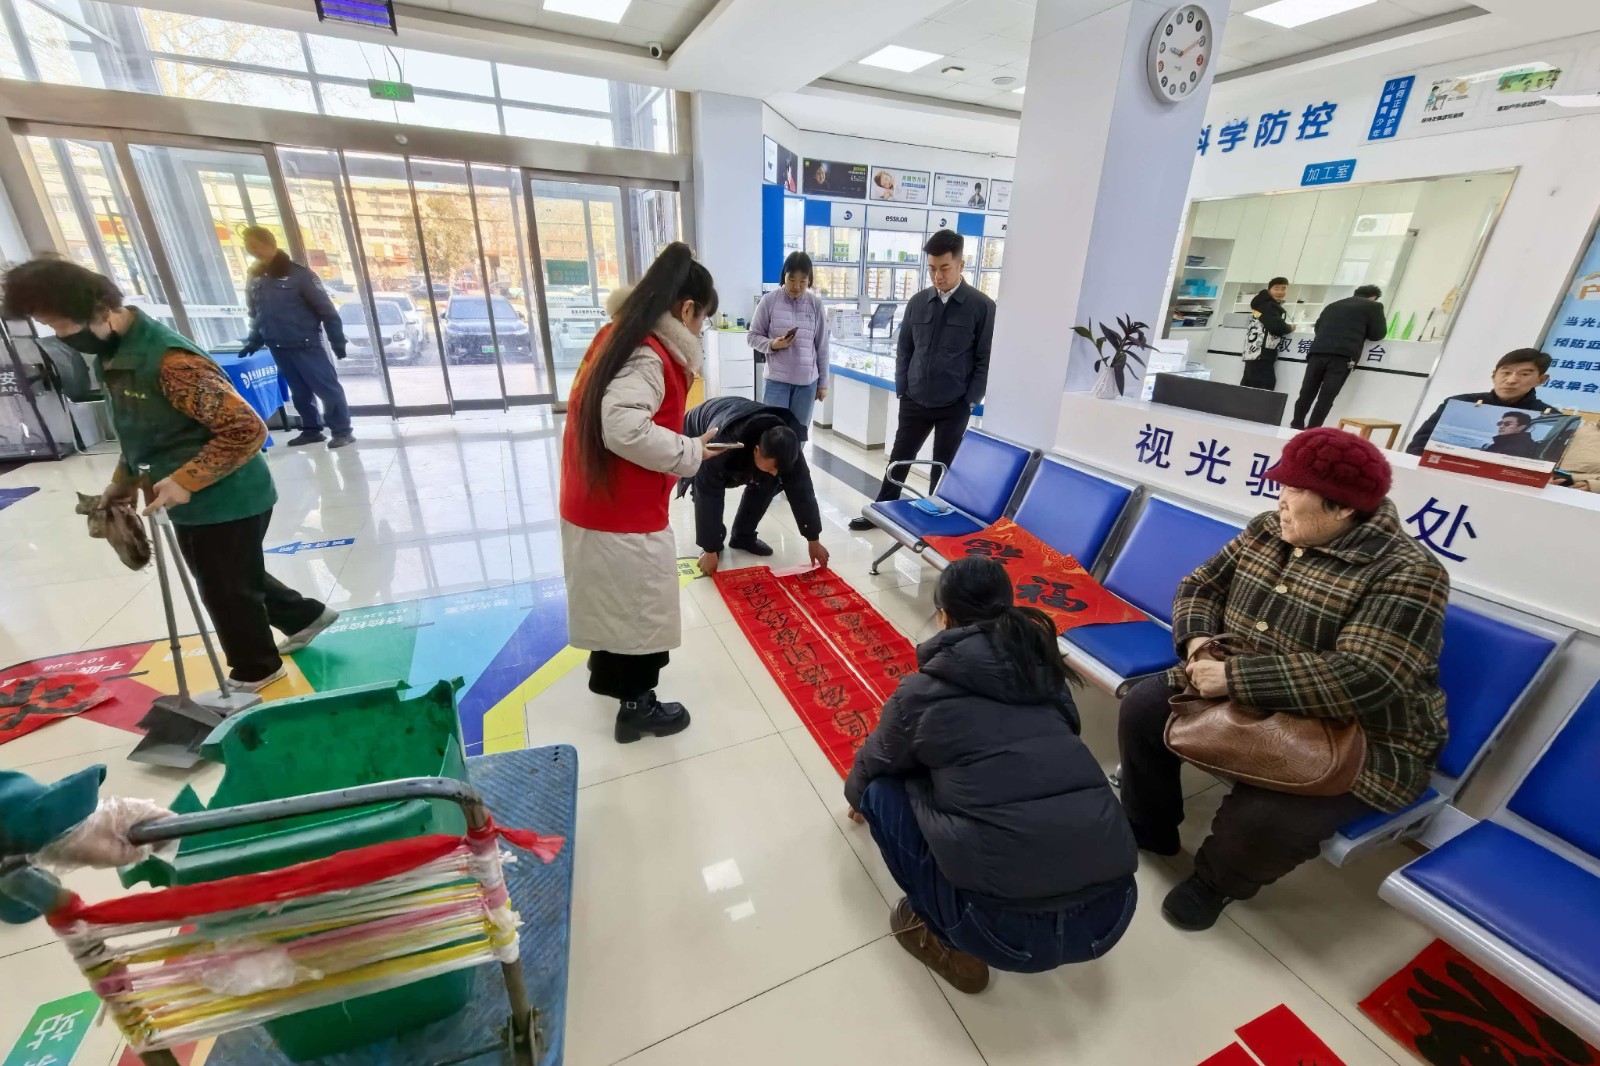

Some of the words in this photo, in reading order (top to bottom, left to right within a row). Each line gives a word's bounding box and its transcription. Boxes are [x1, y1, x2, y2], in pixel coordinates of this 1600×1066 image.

[1305, 163, 1350, 182] 加工室
[1563, 316, 1600, 328] 当光
[1543, 378, 1600, 393] 效果会
[1015, 575, 1088, 613] 福
